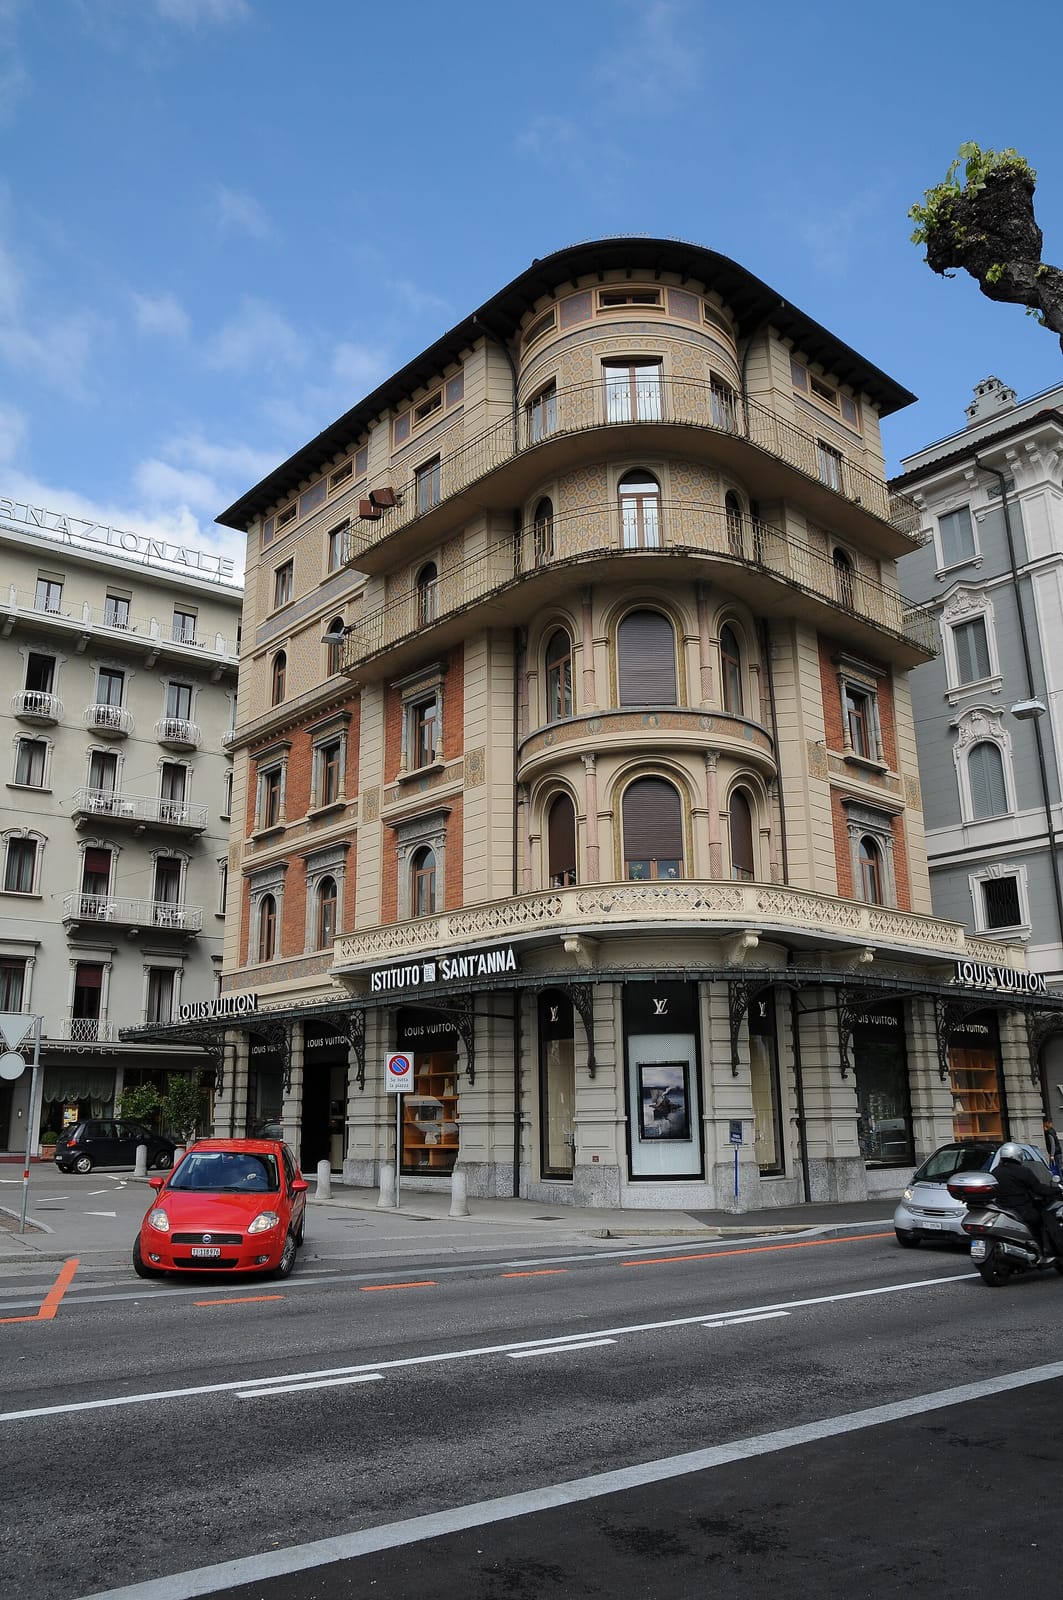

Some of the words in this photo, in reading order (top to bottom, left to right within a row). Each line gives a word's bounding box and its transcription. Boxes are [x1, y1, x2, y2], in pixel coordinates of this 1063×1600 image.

[371, 965, 420, 992] ISTITUTO
[441, 949, 517, 981] SANT'ANNA
[957, 961, 995, 985] LOUIS
[996, 967, 1047, 991] VUITTON
[179, 1002, 209, 1019] LOUIS
[210, 994, 257, 1017] VUITTON
[870, 1015, 898, 1026] VUITTON
[404, 1026, 425, 1037] LOUIS
[965, 1023, 989, 1034] VUITTON
[307, 1038, 324, 1048] LOUIS
[63, 1044, 118, 1055] HOTEL
